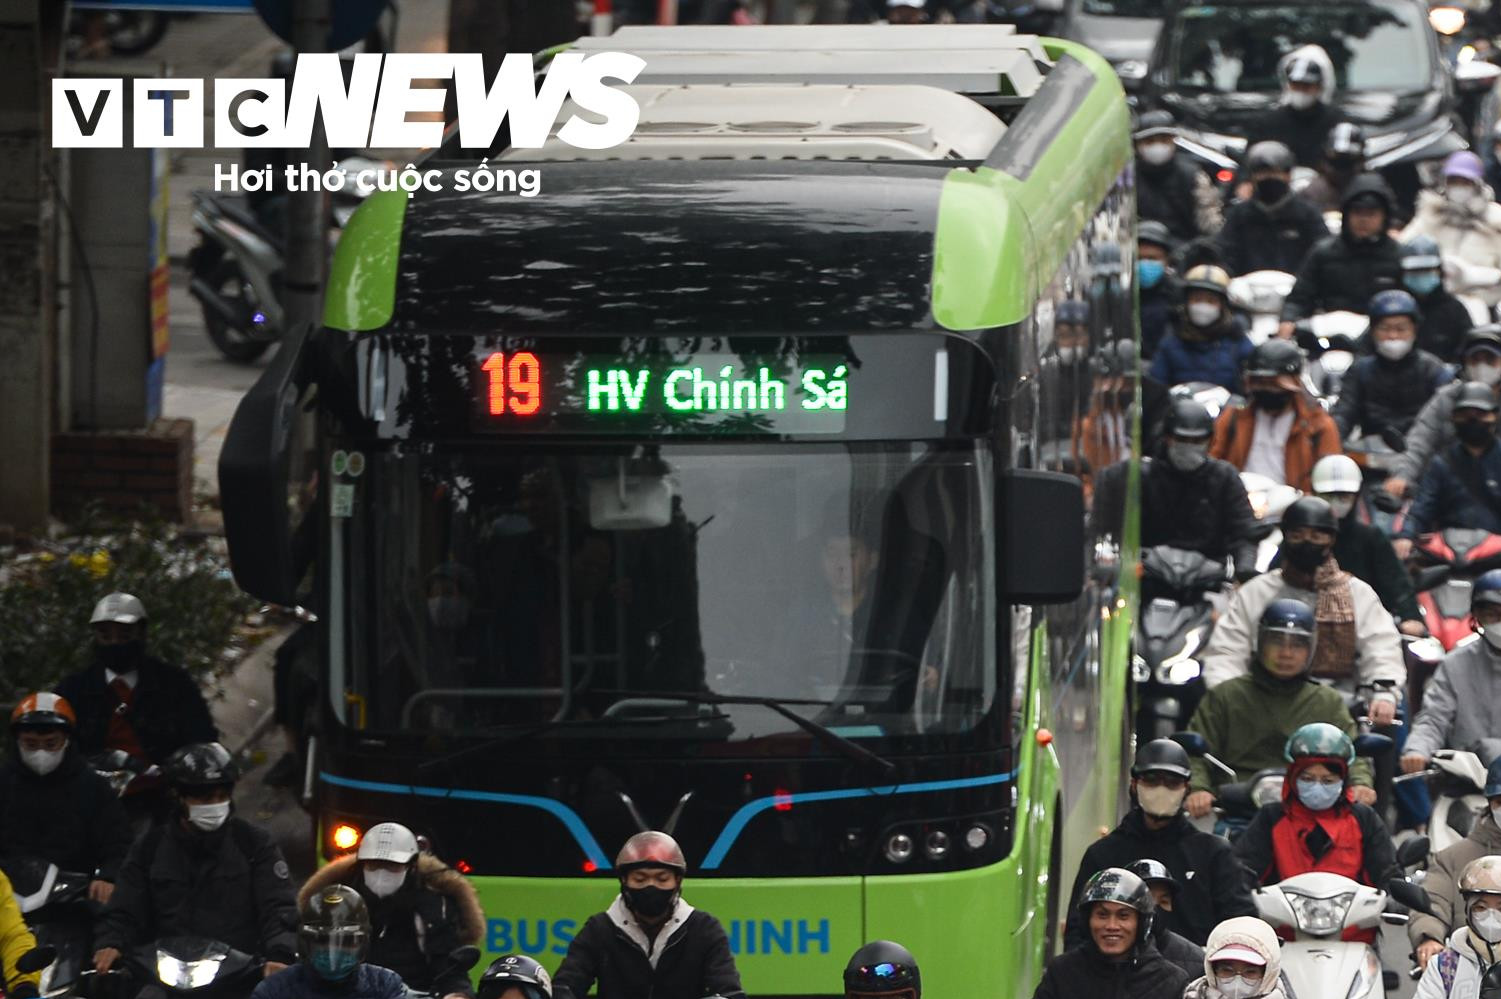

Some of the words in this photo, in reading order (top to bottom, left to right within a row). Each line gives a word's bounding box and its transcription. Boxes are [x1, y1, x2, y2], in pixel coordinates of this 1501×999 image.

[481, 352, 540, 415] 19
[587, 369, 650, 410] HV
[663, 365, 785, 410] Chính
[801, 365, 848, 410] Sá
[485, 918, 578, 955] BUS
